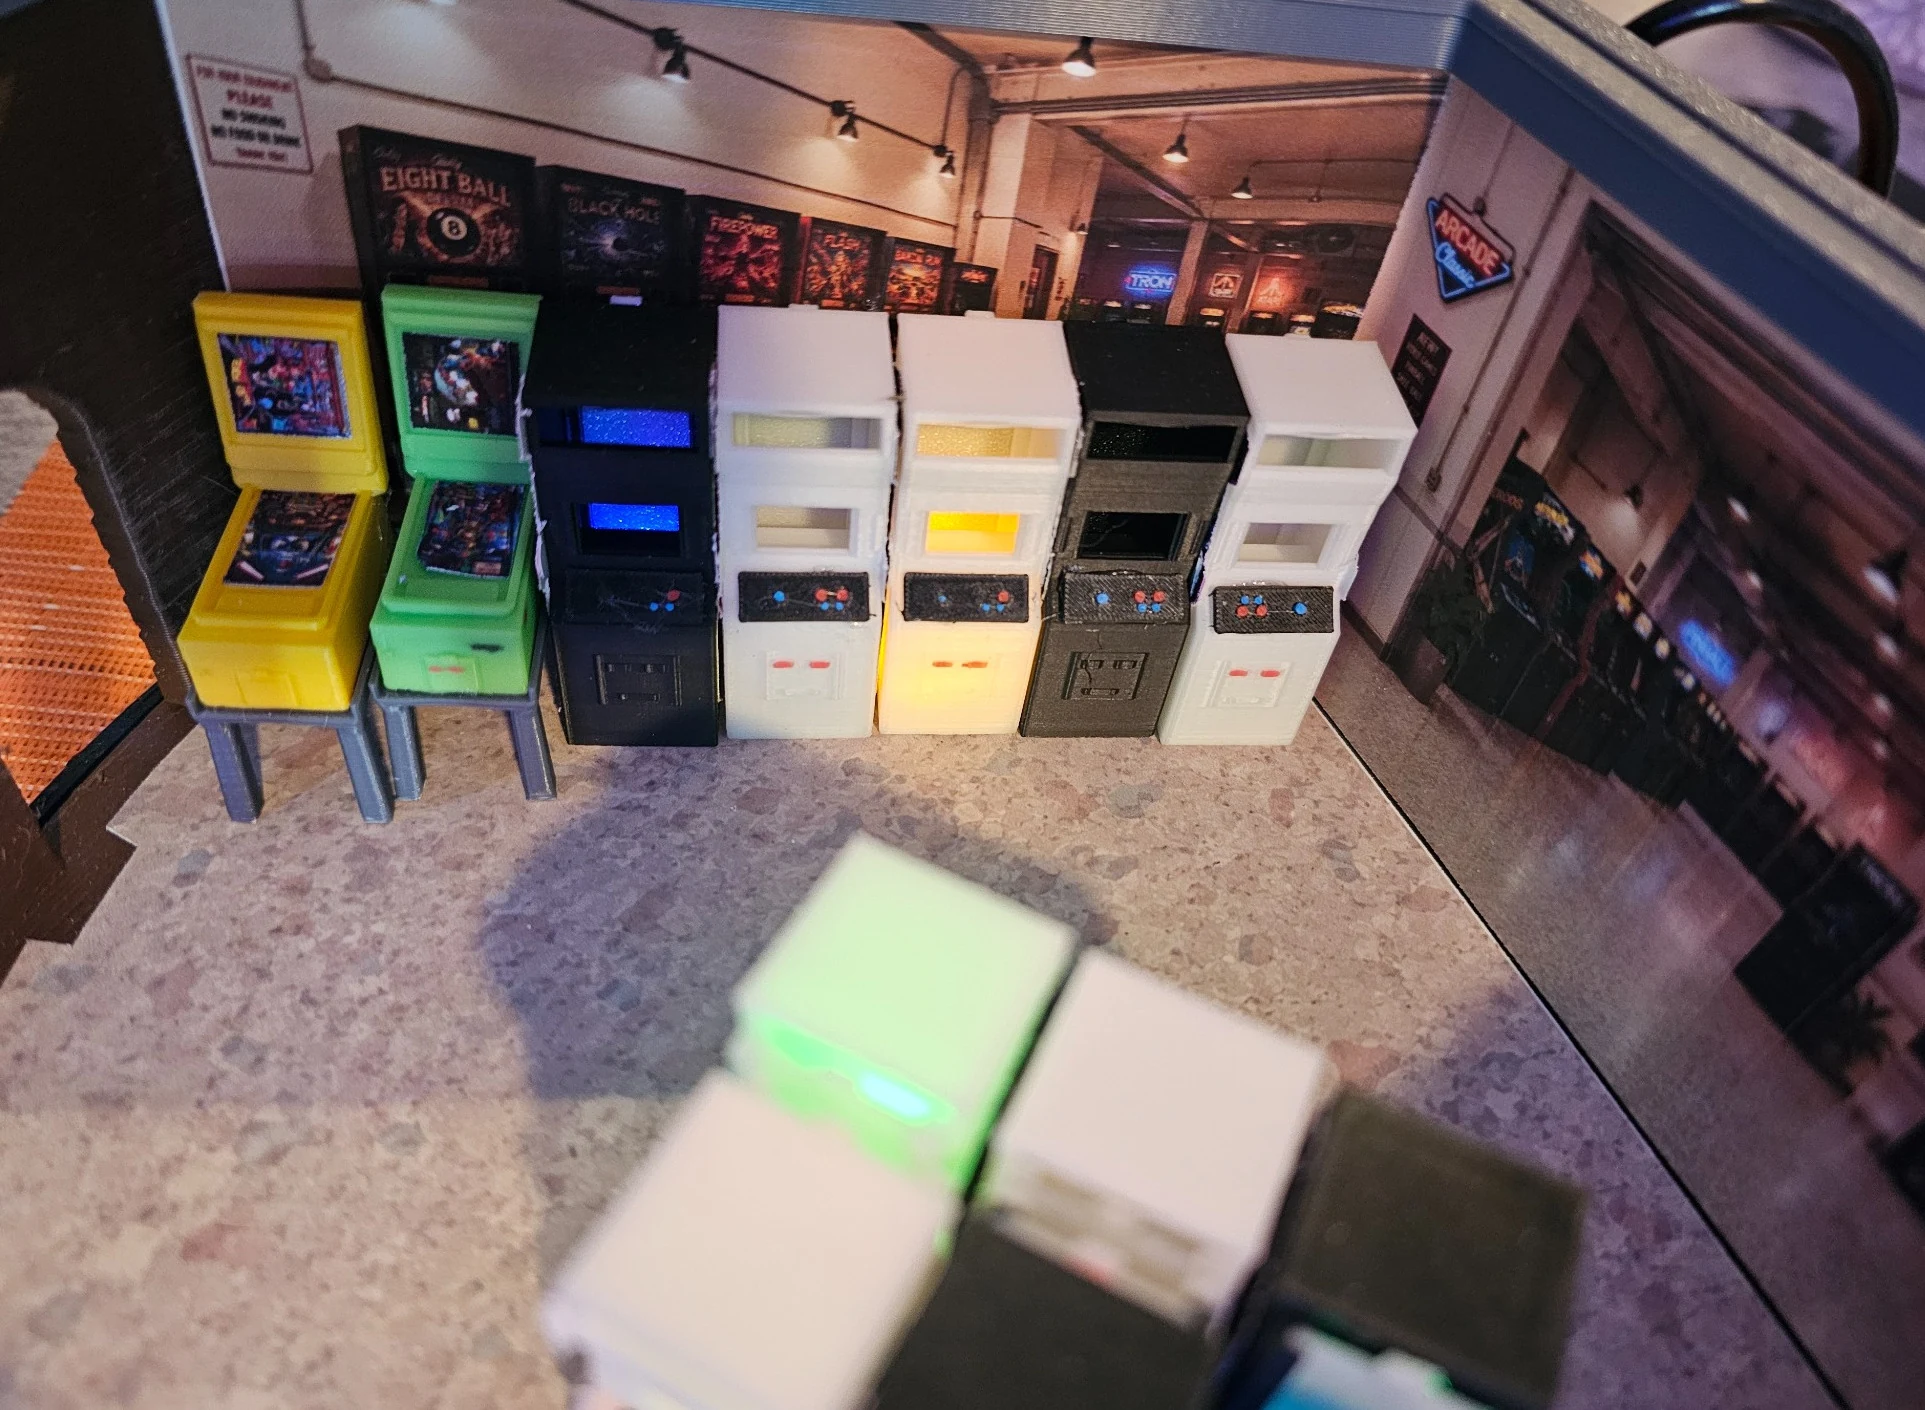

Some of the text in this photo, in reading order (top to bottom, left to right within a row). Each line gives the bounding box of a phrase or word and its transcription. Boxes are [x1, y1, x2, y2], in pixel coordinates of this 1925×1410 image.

[380, 166, 450, 192] EIGHT
[456, 172, 511, 207] BALL
[448, 220, 460, 236] 8
[1435, 208, 1500, 277] ARCADE
[1130, 273, 1173, 290] TRON
